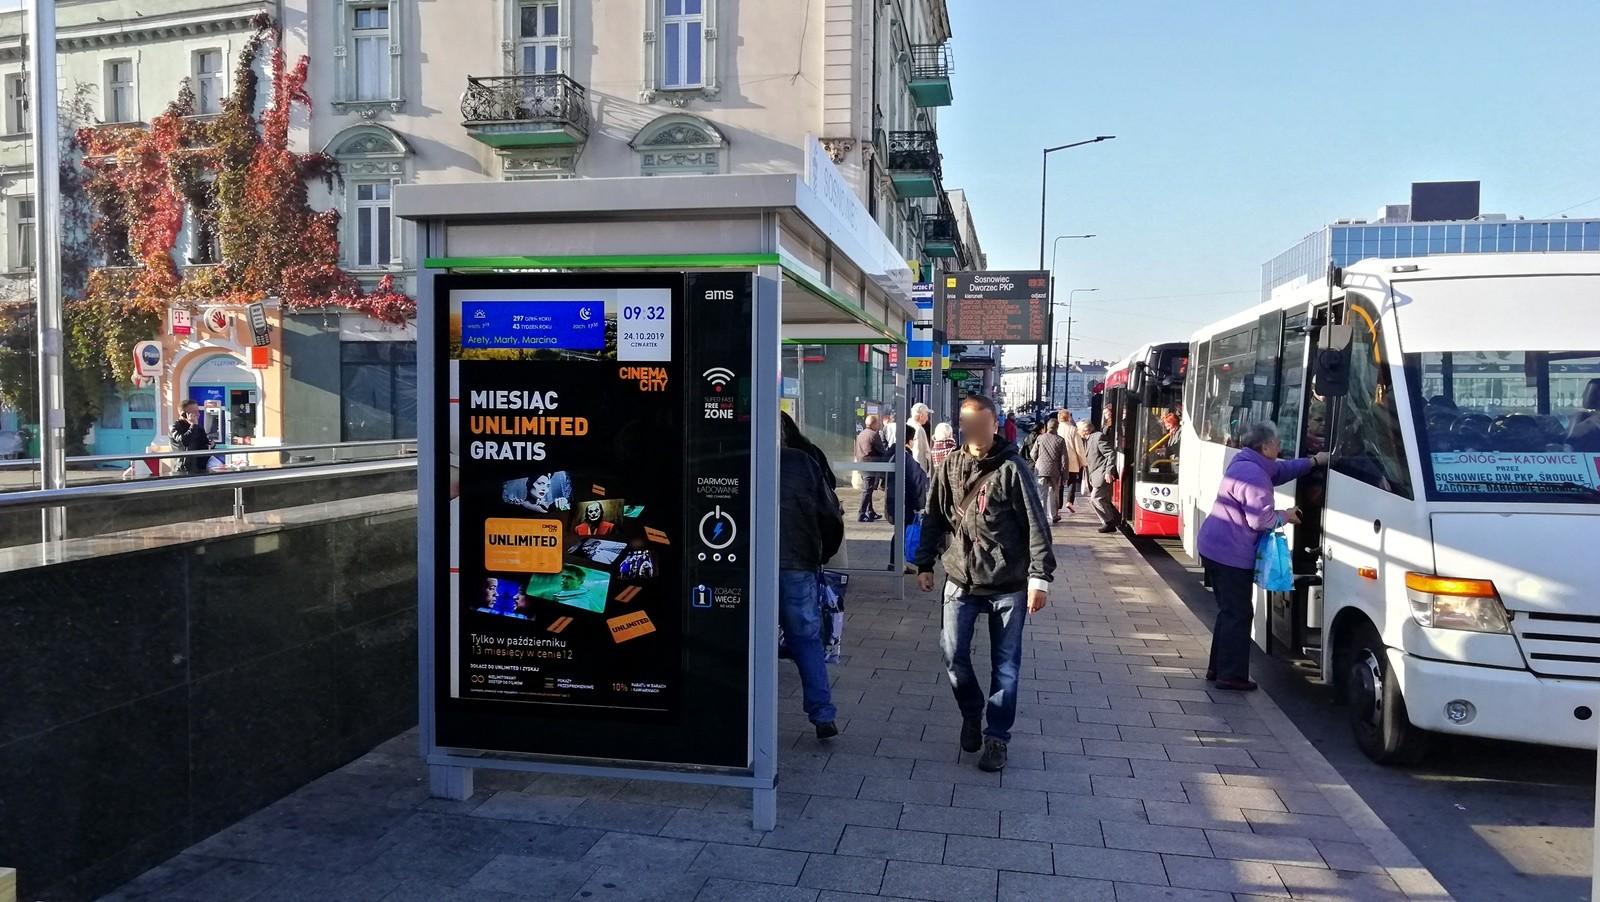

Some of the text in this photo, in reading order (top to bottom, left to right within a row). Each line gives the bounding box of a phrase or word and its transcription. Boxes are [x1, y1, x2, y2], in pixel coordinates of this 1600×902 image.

[974, 275, 1010, 283] Sosnowiec
[969, 283, 1015, 292] Dworzec PKP
[704, 290, 734, 300] ams
[623, 306, 665, 320] 09:32
[522, 335, 558, 344] Marcina
[624, 332, 665, 341] 24.10.2019
[619, 367, 668, 380] CINEMA
[639, 379, 669, 392] CITY
[470, 390, 559, 414] MIESIĄC
[704, 409, 734, 419] ZONE
[470, 415, 589, 436] UNLIMITED
[470, 441, 546, 460] GRATIS
[1458, 452, 1577, 465] ONÓG KATOWICE
[697, 477, 739, 486] DARMOWE
[1435, 472, 1493, 483] SOSNOWIEC
[488, 533, 558, 548] UNLIMITED
[714, 587, 741, 596] ZOBACZ
[611, 616, 650, 634] UNLIMITED
[471, 633, 566, 648] Tylko w październiku
[472, 645, 482, 655] 13
[612, 682, 628, 692] 10%
